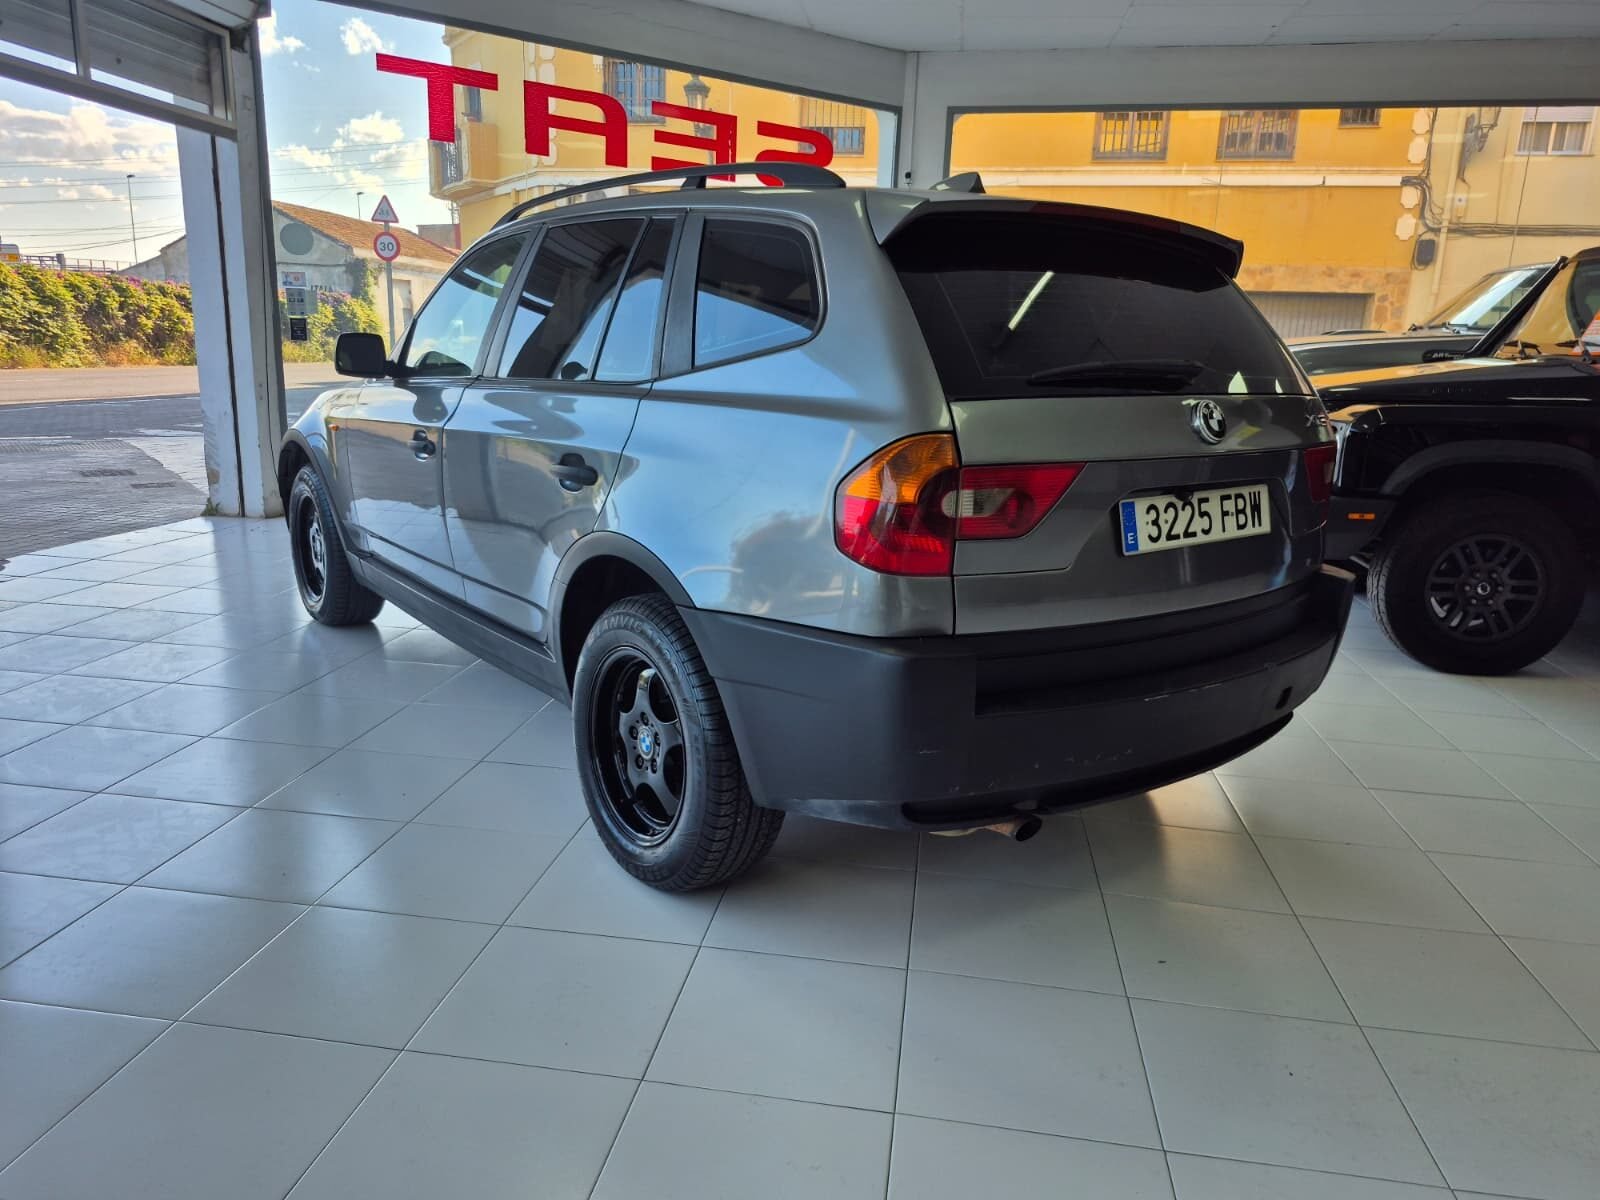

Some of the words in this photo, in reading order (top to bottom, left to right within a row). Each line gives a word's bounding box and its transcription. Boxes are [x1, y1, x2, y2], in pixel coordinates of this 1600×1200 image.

[379, 242, 394, 252] 30
[1145, 498, 1213, 543] 3225
[1219, 490, 1263, 533] FBW
[1127, 532, 1136, 545] E
